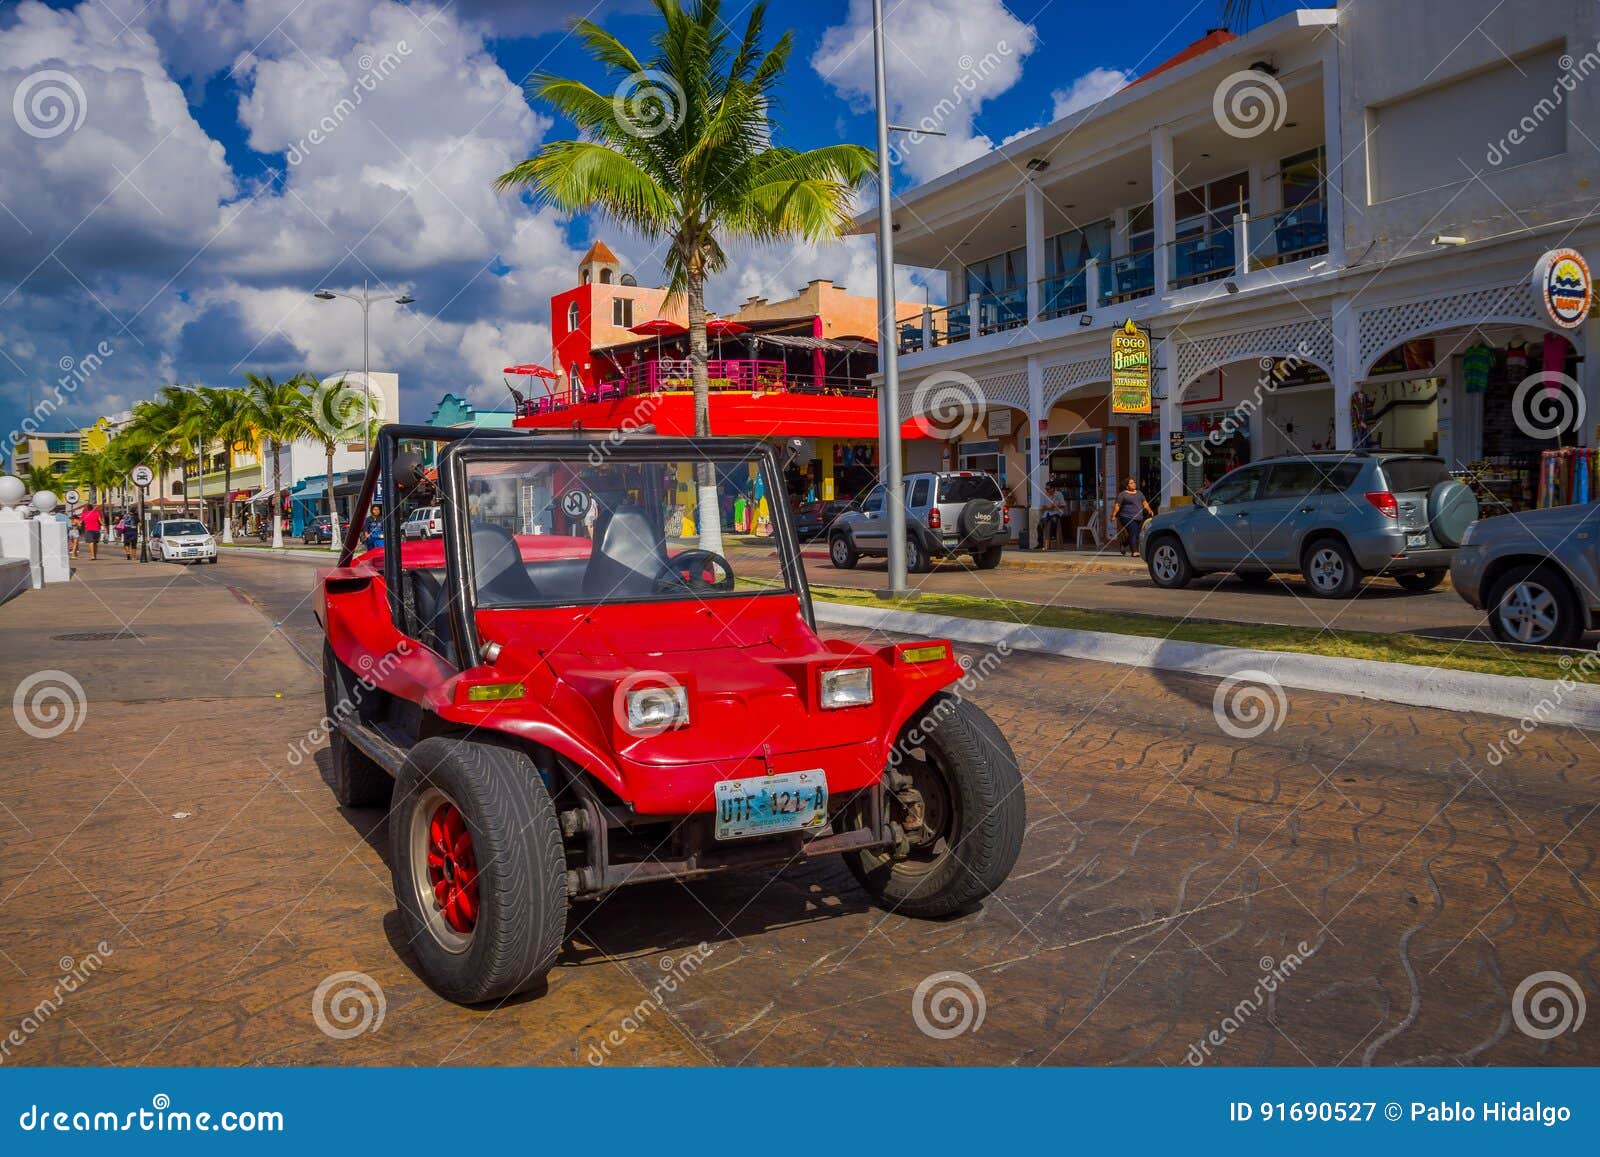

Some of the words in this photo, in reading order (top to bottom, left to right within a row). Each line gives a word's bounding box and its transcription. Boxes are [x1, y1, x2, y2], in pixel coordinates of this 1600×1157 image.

[1116, 337, 1145, 348] FOGO
[1113, 351, 1148, 370] BRASIL
[974, 512, 992, 521] Jeep
